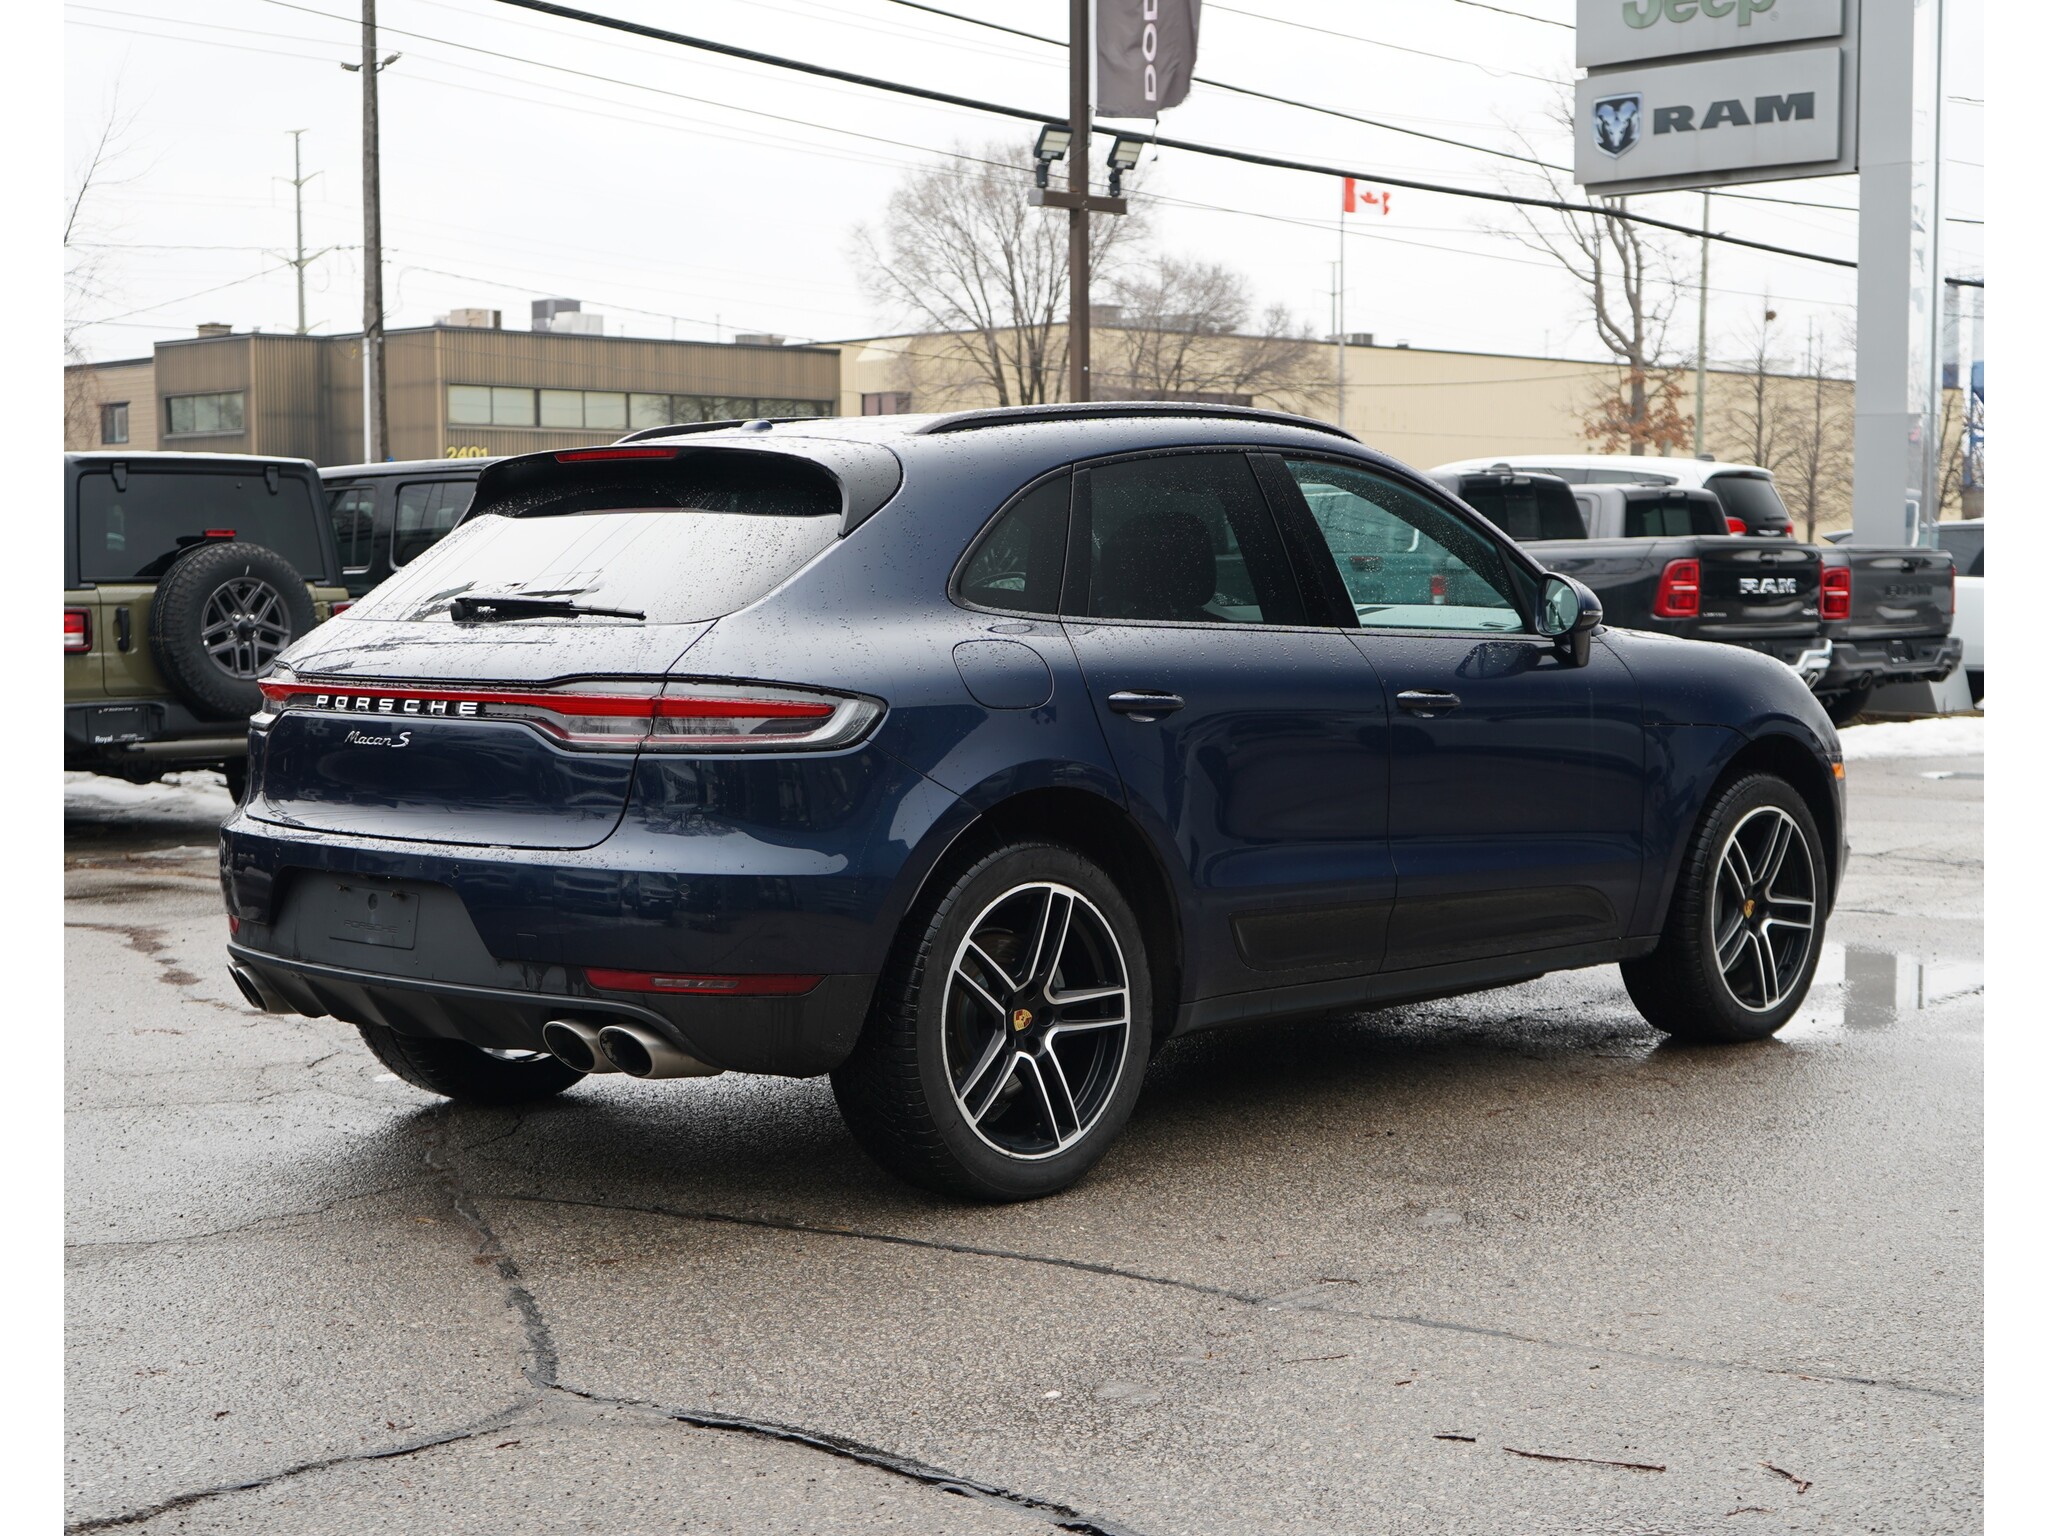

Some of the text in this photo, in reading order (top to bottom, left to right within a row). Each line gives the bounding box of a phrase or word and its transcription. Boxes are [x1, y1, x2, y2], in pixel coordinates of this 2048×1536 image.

[1653, 91, 1815, 135] RAM
[446, 446, 488, 459] 2401
[1739, 578, 1797, 594] RAM
[316, 694, 478, 715] PORSCHE
[344, 731, 412, 747] Macan S
